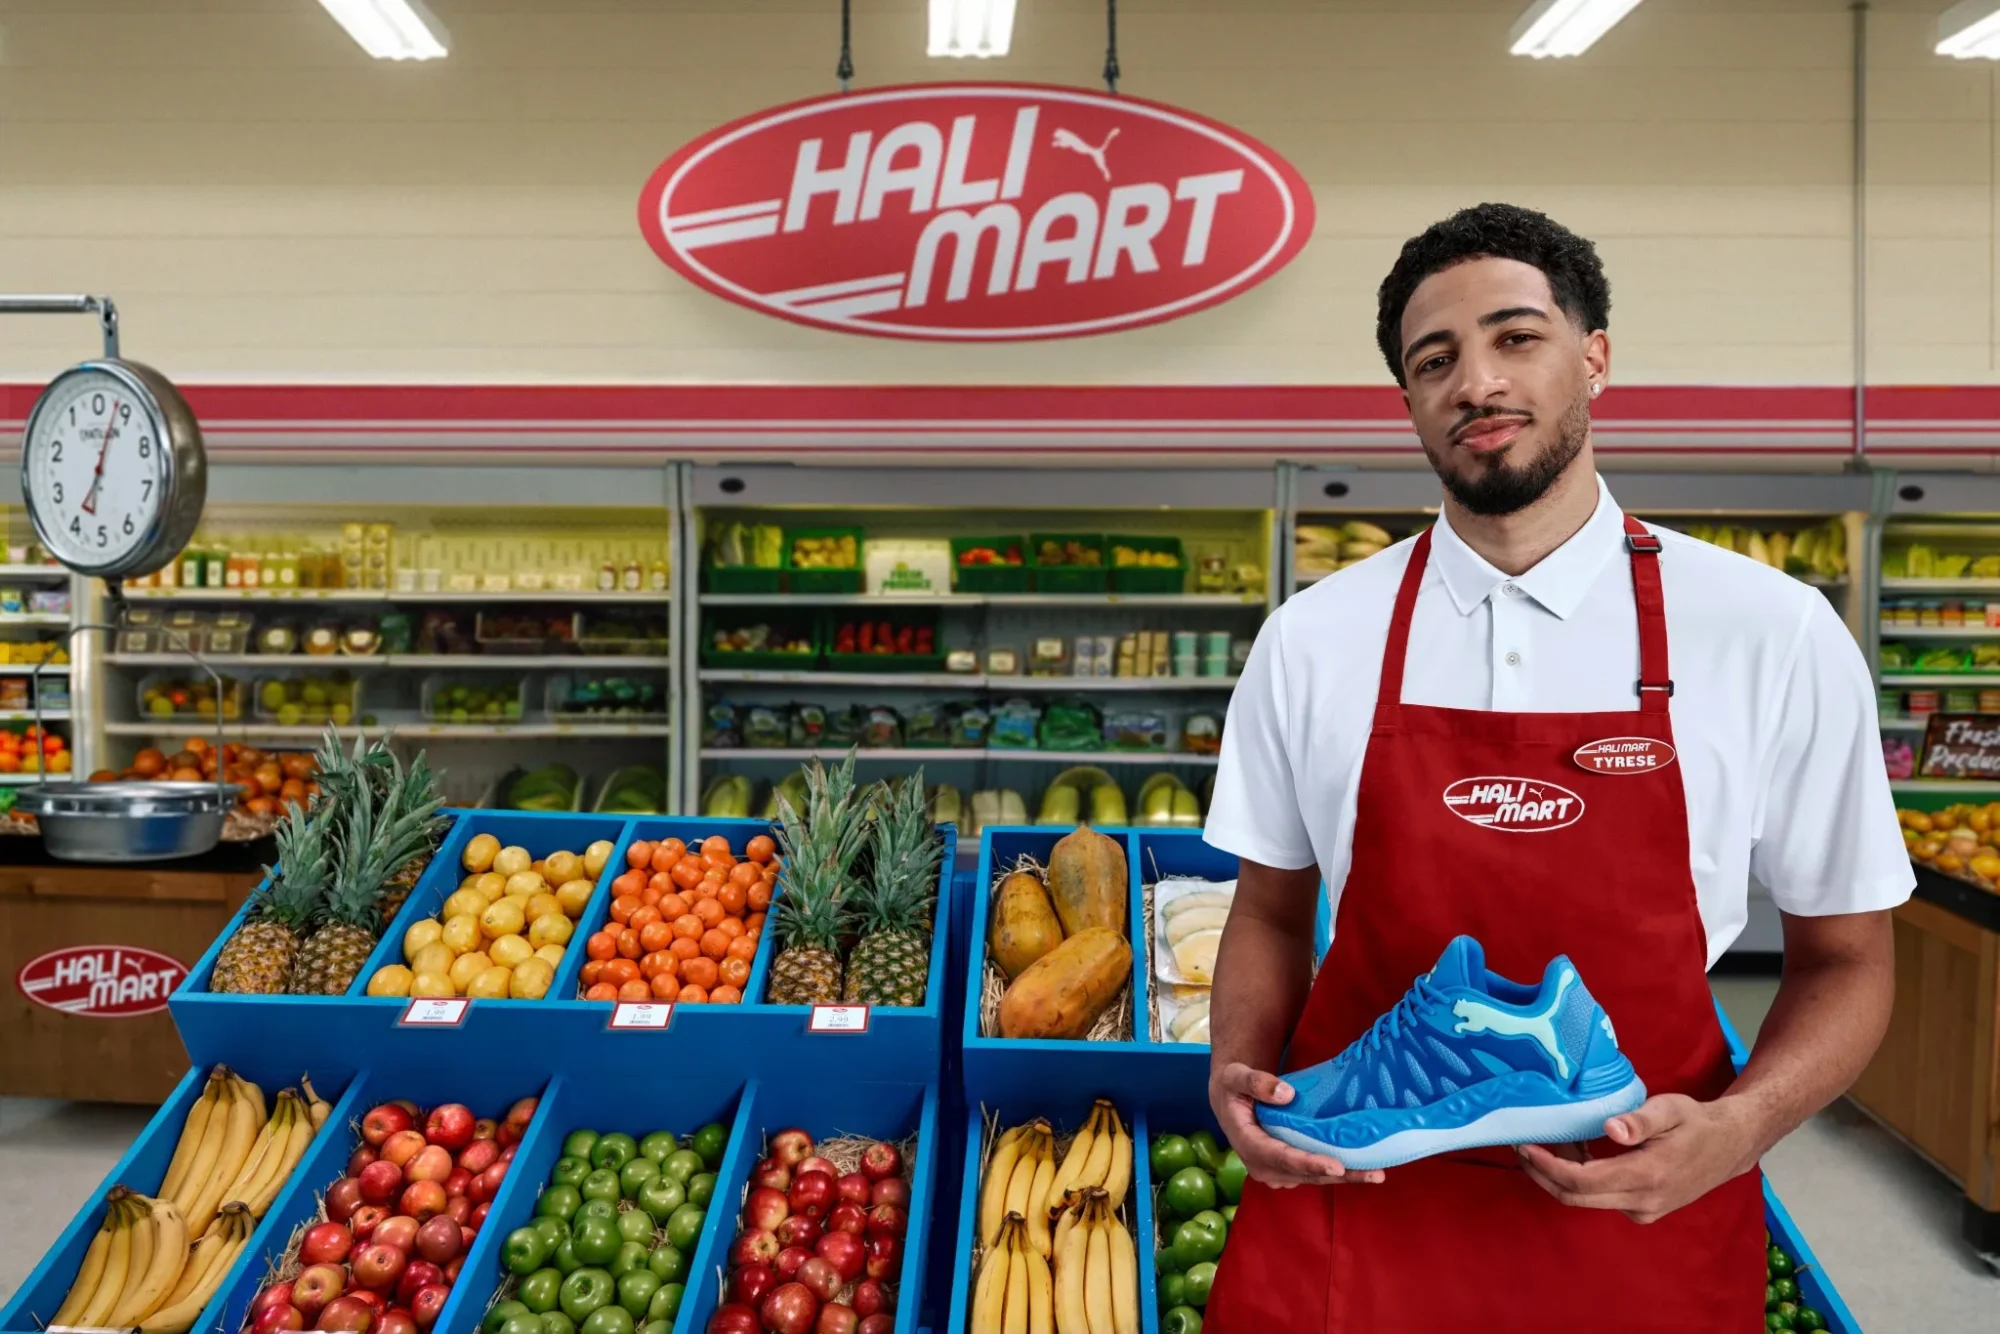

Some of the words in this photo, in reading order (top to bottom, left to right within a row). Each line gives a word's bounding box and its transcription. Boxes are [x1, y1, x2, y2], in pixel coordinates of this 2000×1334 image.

[783, 105, 1041, 232] HALI
[903, 167, 1244, 308] MART
[92, 393, 105, 416] 0
[119, 404, 132, 426] 9
[69, 406, 76, 427] 1
[51, 440, 63, 462] 2
[138, 436, 151, 458] 8
[53, 482, 64, 504] 3
[141, 480, 153, 502] 7
[69, 515, 81, 537] 4
[122, 513, 134, 535] 6
[97, 526, 108, 548] 5
[1597, 743, 1620, 754] HALI
[1621, 742, 1651, 753] MART
[1593, 755, 1656, 768] TYRESE
[1469, 782, 1527, 805] HALI
[1493, 797, 1574, 823] MART
[54, 950, 121, 987] HALI
[88, 968, 177, 1008] MART
